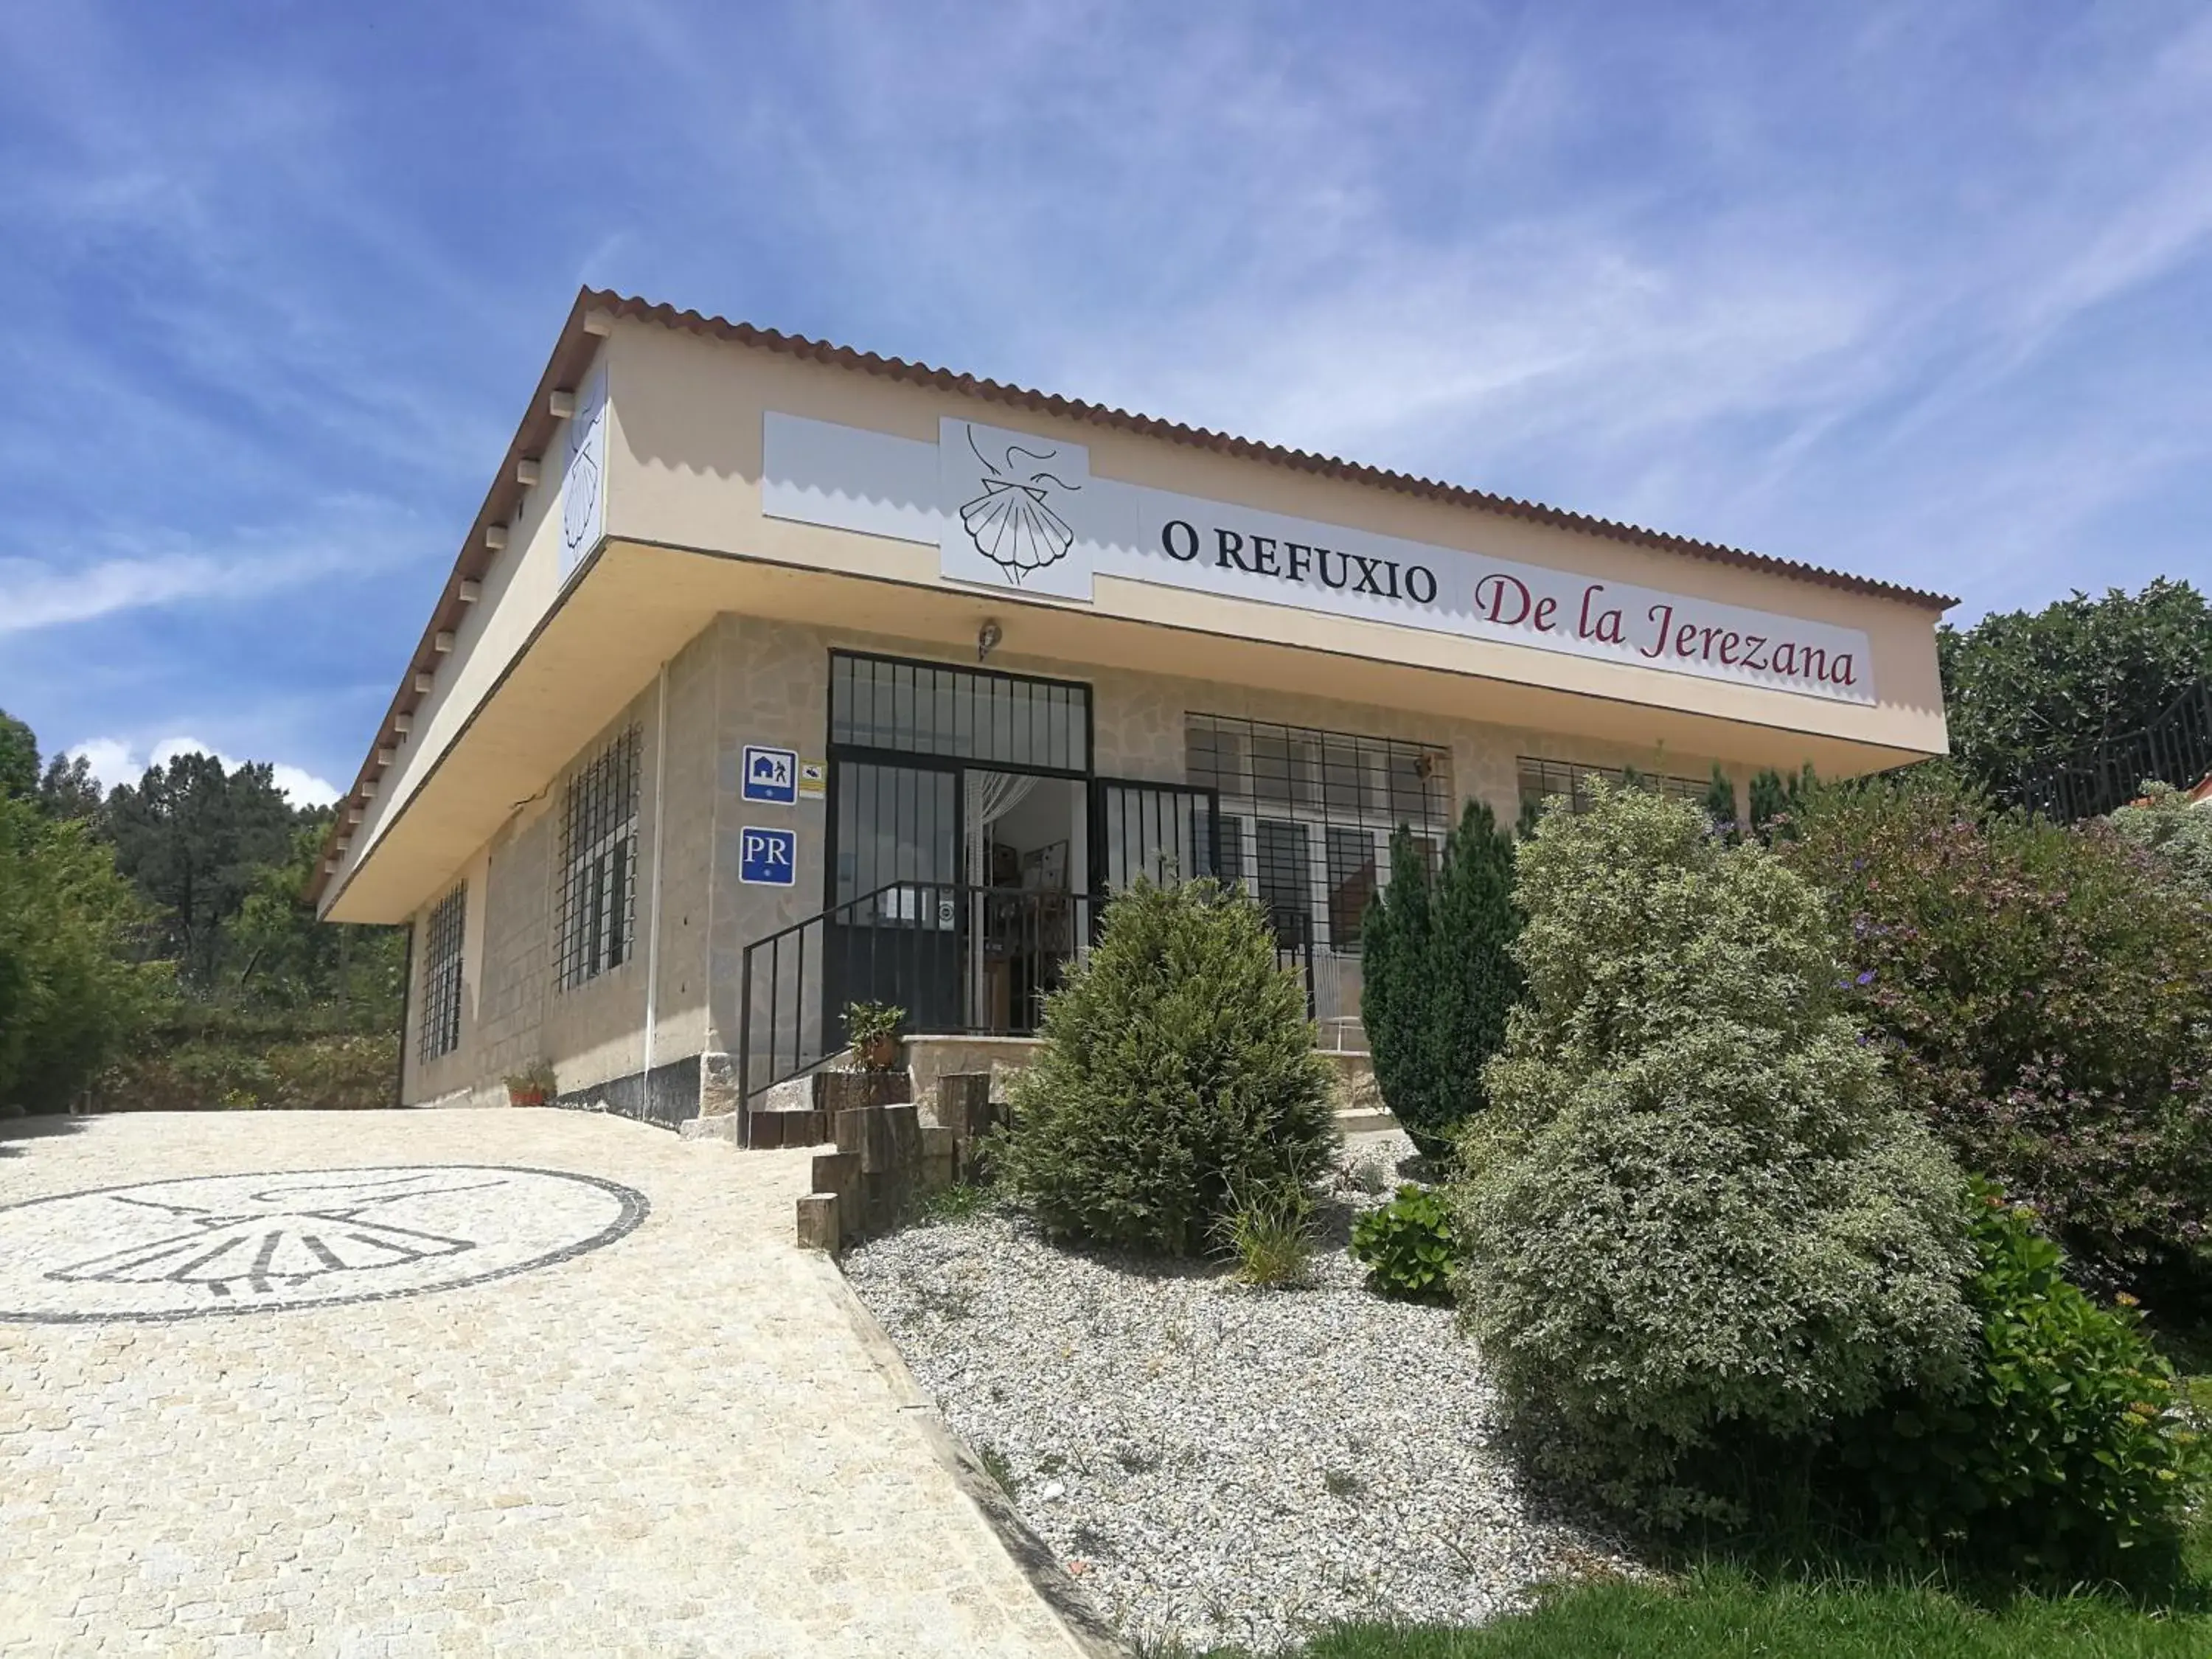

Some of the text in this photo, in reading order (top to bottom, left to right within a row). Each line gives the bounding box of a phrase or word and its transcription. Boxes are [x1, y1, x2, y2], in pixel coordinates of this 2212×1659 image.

[1161, 520, 1857, 686] O REFUXIO De la Jerezana
[745, 835, 790, 865] PR
